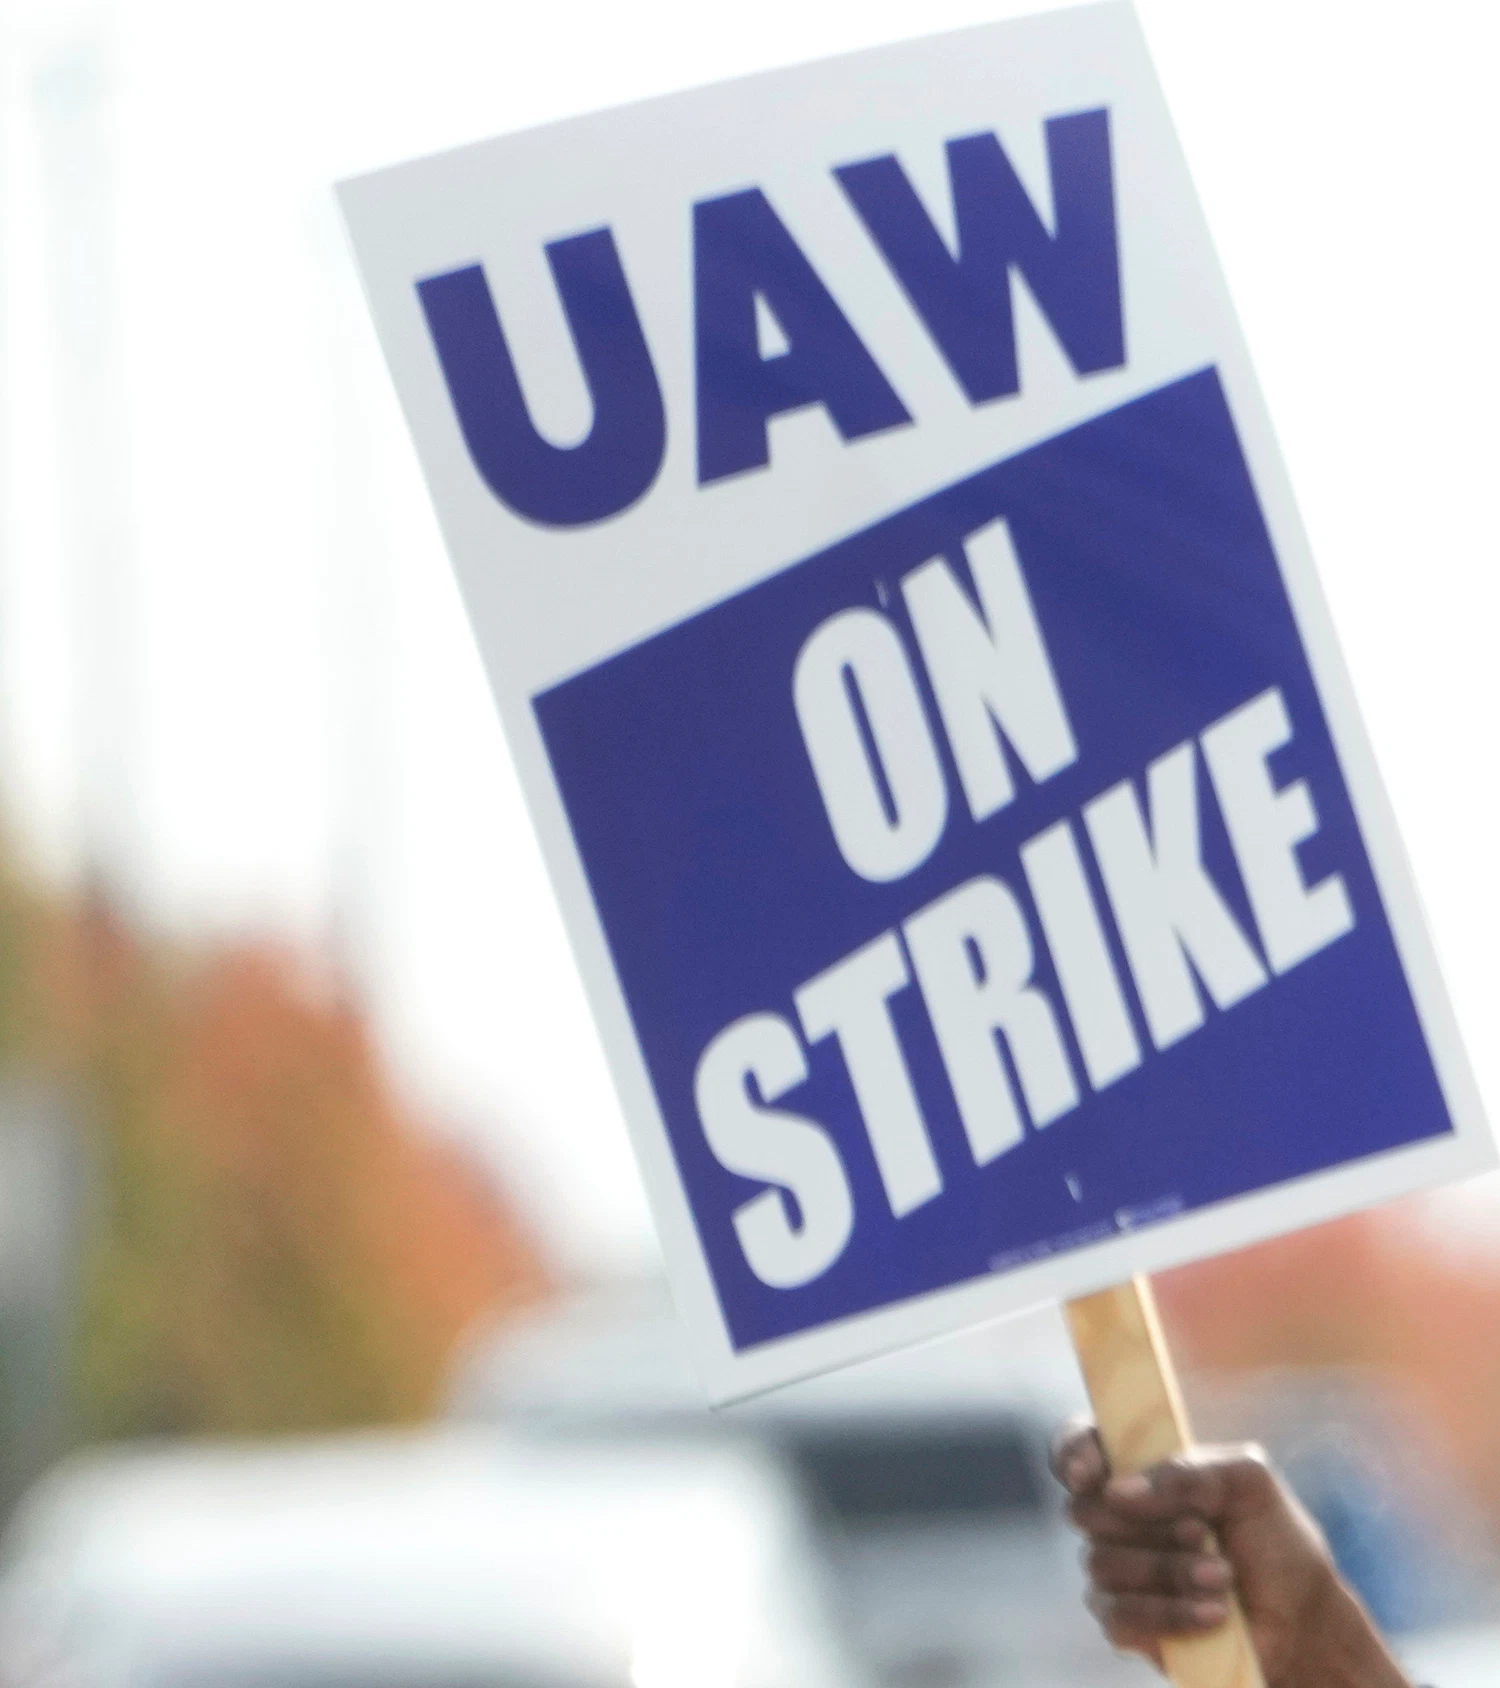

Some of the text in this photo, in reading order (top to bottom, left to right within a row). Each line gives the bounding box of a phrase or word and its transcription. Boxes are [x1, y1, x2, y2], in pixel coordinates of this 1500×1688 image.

[414, 105, 1127, 533] UAW
[792, 516, 1079, 885] ON
[694, 686, 1355, 1289] STRIKE
